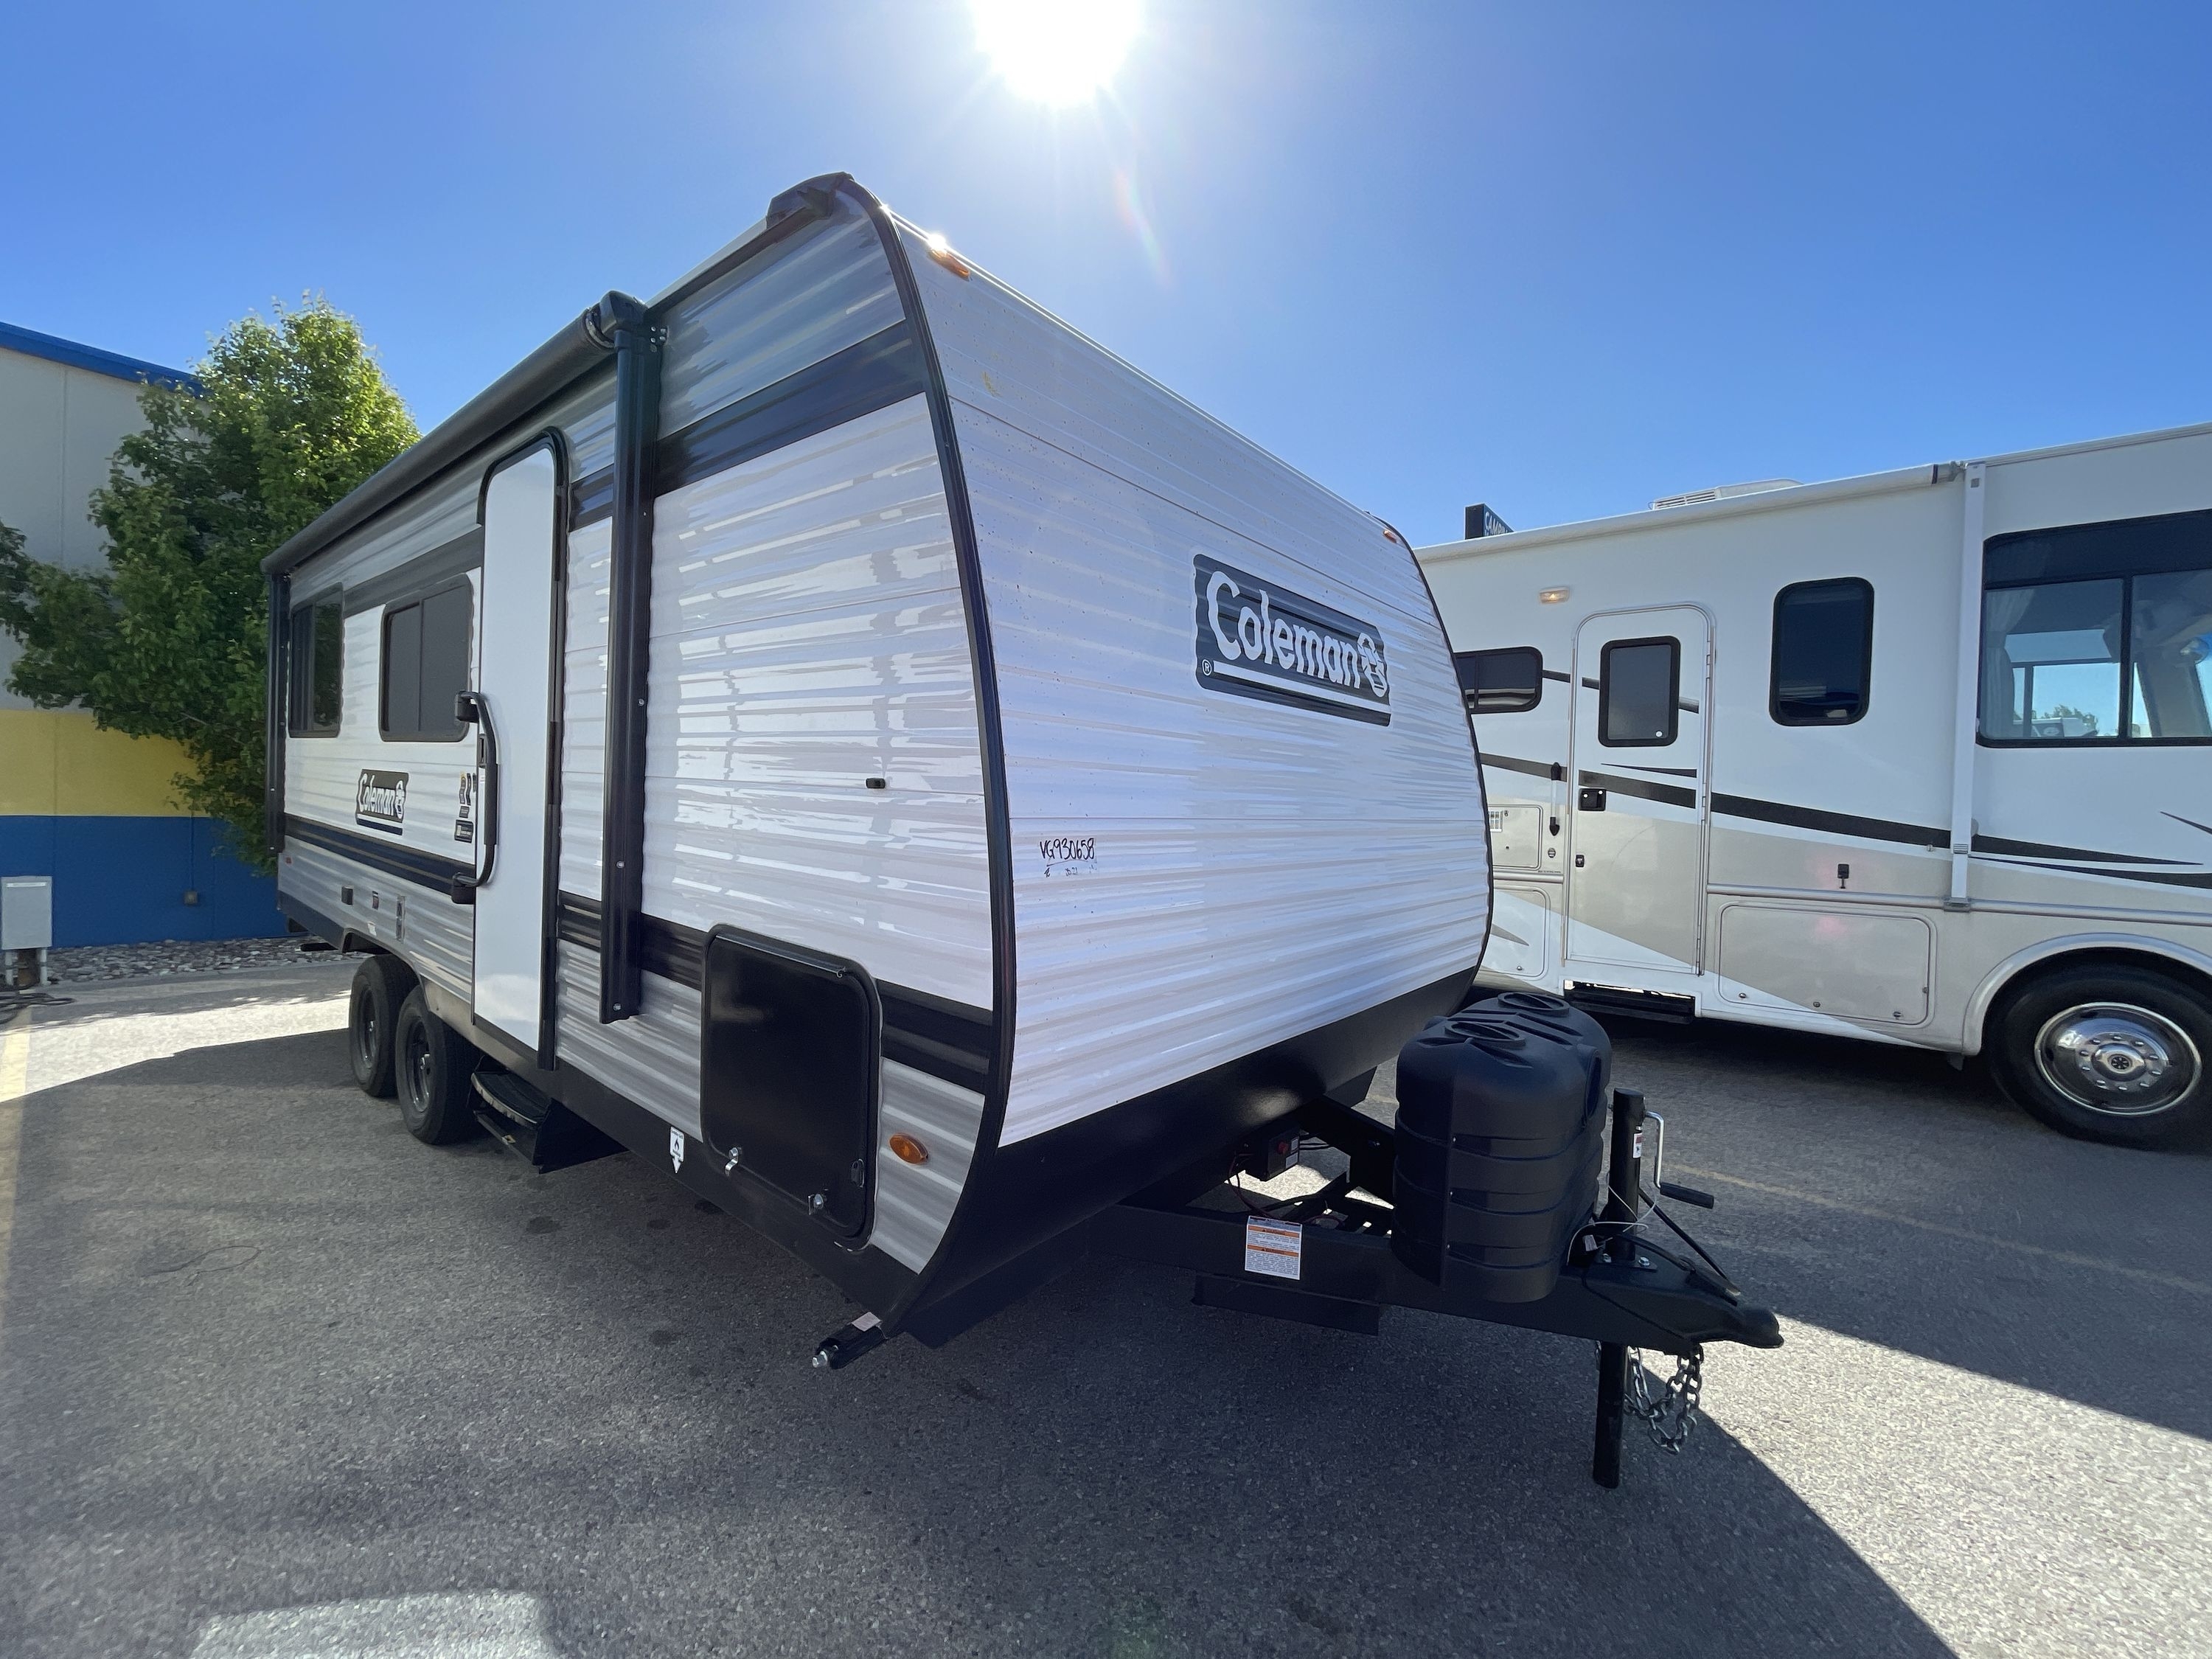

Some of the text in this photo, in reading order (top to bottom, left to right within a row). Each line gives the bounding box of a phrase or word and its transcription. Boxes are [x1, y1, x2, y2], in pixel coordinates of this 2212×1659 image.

[1206, 571, 1361, 689] Coleman
[358, 773, 396, 816] Coleman
[1040, 838, 1094, 860] VG930658
